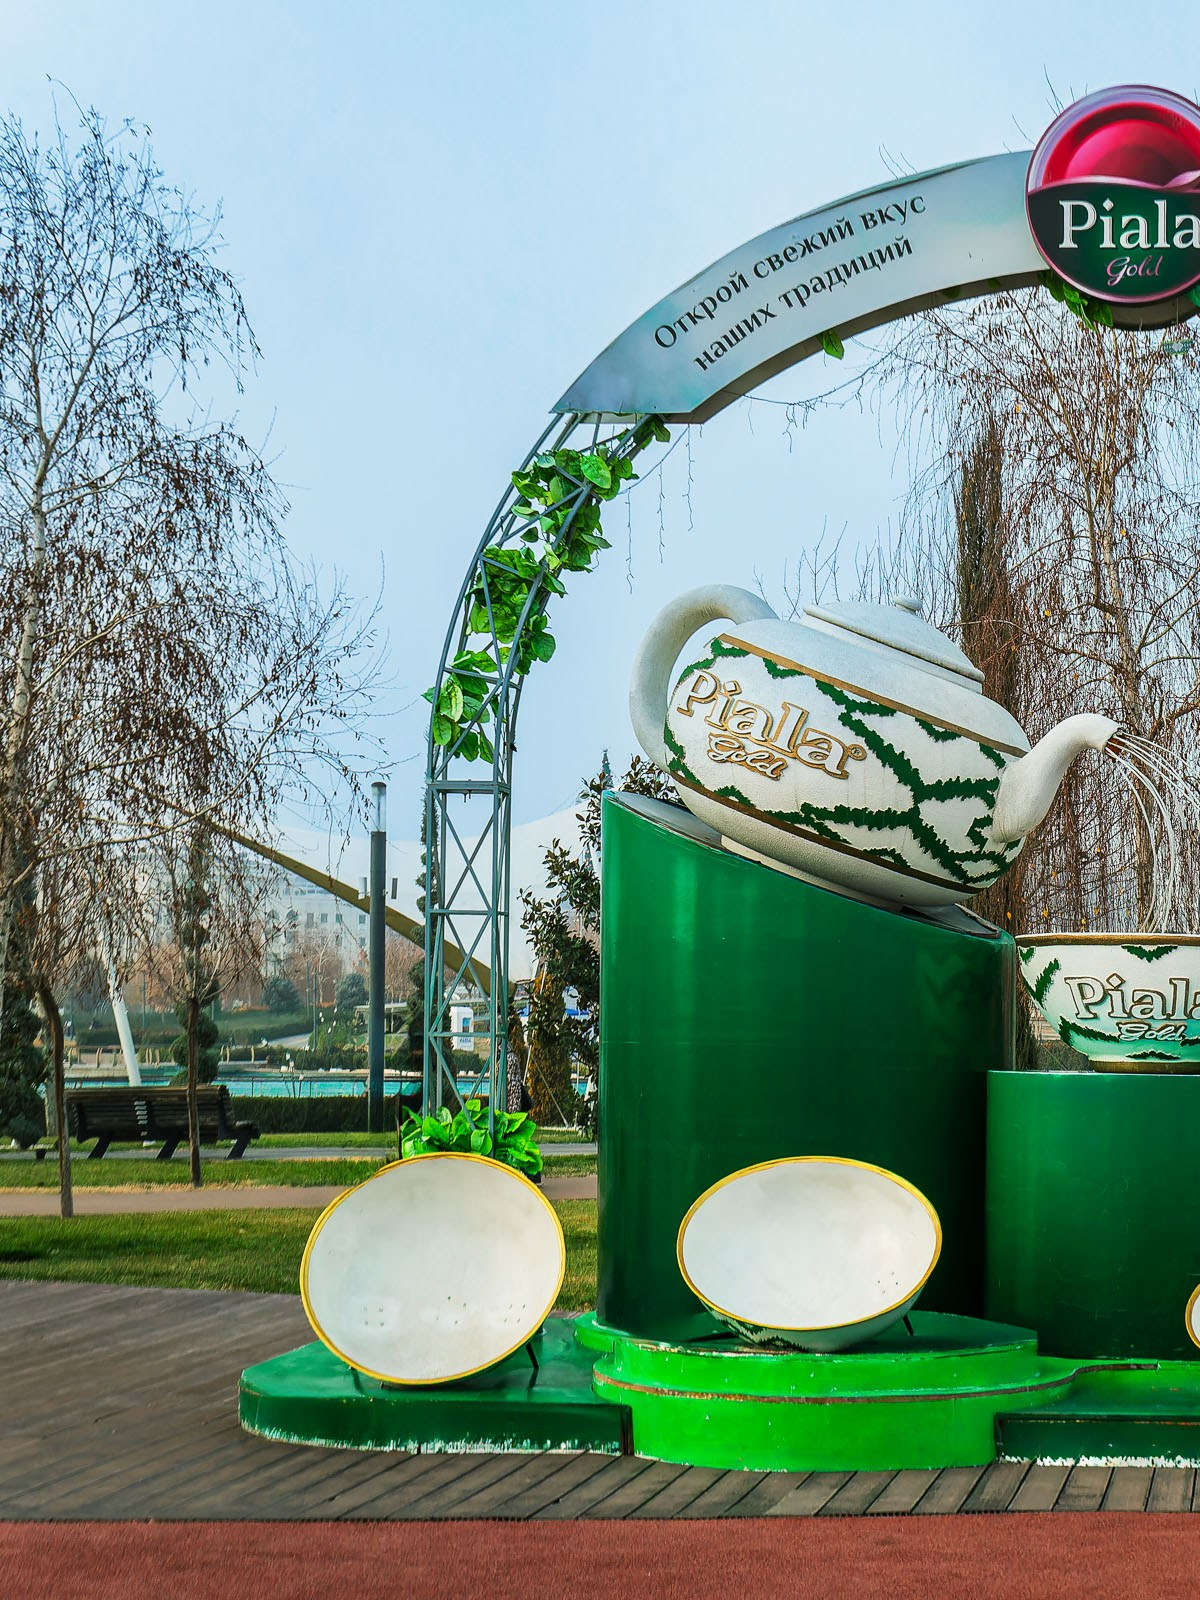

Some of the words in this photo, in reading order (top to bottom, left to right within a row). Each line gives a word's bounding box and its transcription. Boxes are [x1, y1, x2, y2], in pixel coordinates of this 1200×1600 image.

[654, 271, 750, 349] Открой
[753, 217, 854, 280] свежий
[860, 195, 927, 231] вкус
[693, 303, 778, 371] наших
[778, 235, 914, 307] традиций
[1106, 255, 1163, 286] Gold
[1116, 1020, 1186, 1041] Gold
